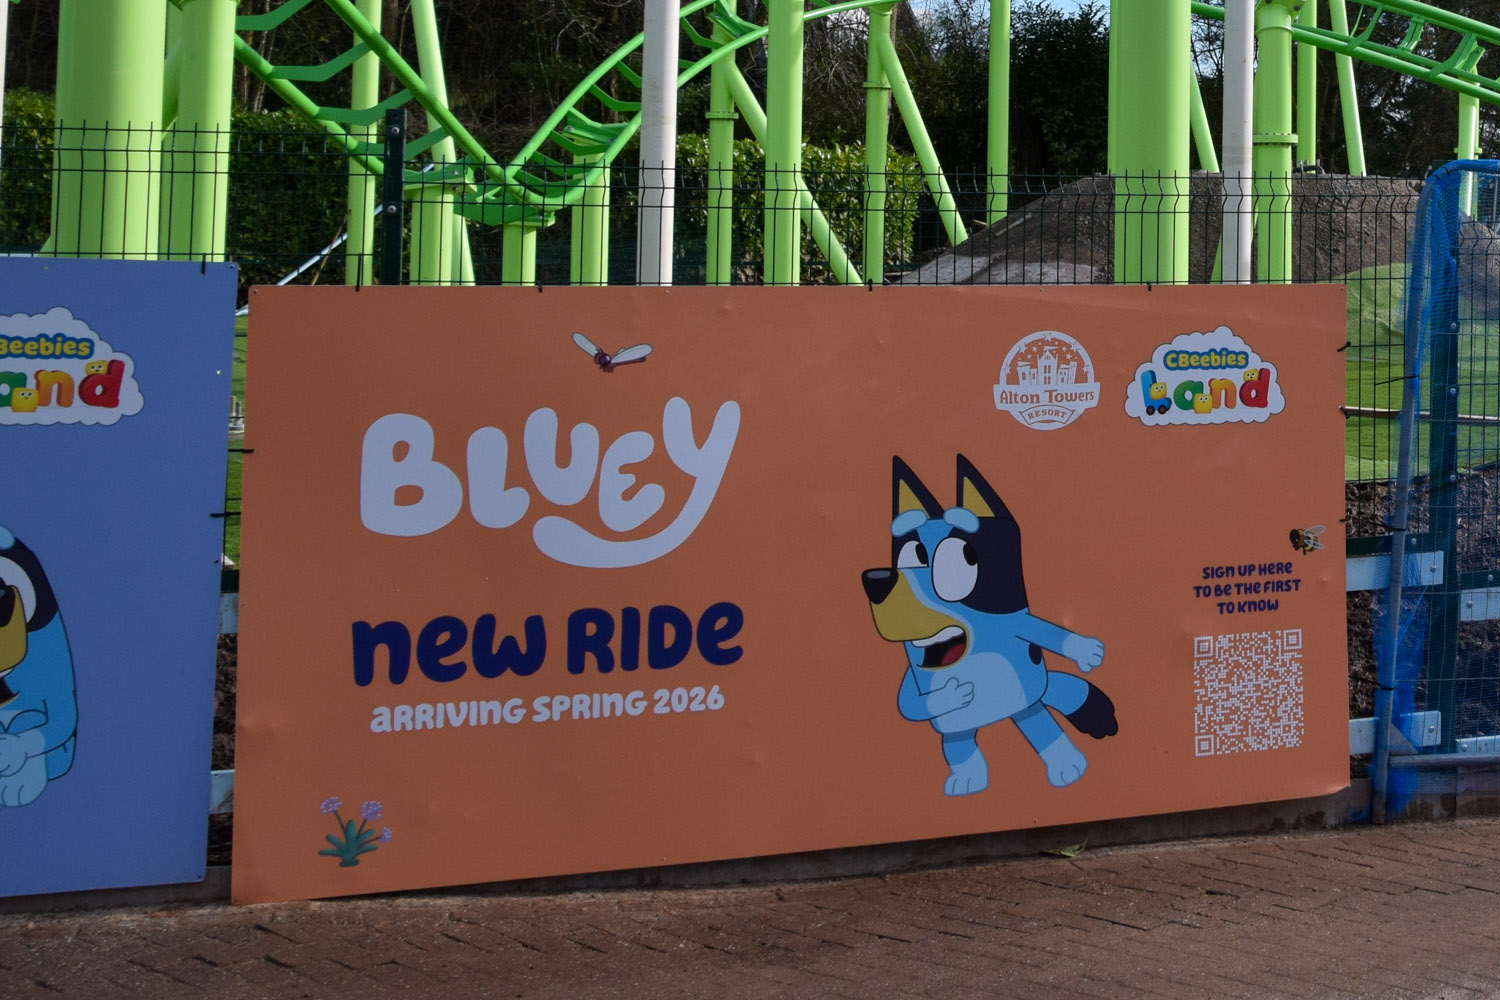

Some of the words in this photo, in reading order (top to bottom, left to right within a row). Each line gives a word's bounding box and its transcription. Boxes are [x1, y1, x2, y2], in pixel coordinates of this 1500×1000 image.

[0, 337, 91, 356] Beebies
[1166, 351, 1246, 367] CBeebies
[0, 359, 125, 408] and
[1141, 368, 1270, 415] Land
[1000, 390, 1040, 404] Alton
[1044, 389, 1094, 403] Towers
[1027, 409, 1066, 420] RESORT
[360, 396, 741, 569] BLUEY
[1238, 564, 1256, 577] UP
[1193, 585, 1212, 598] TO
[1263, 579, 1301, 593] FIRST
[1217, 602, 1235, 615] TO
[653, 685, 725, 715] 2026
